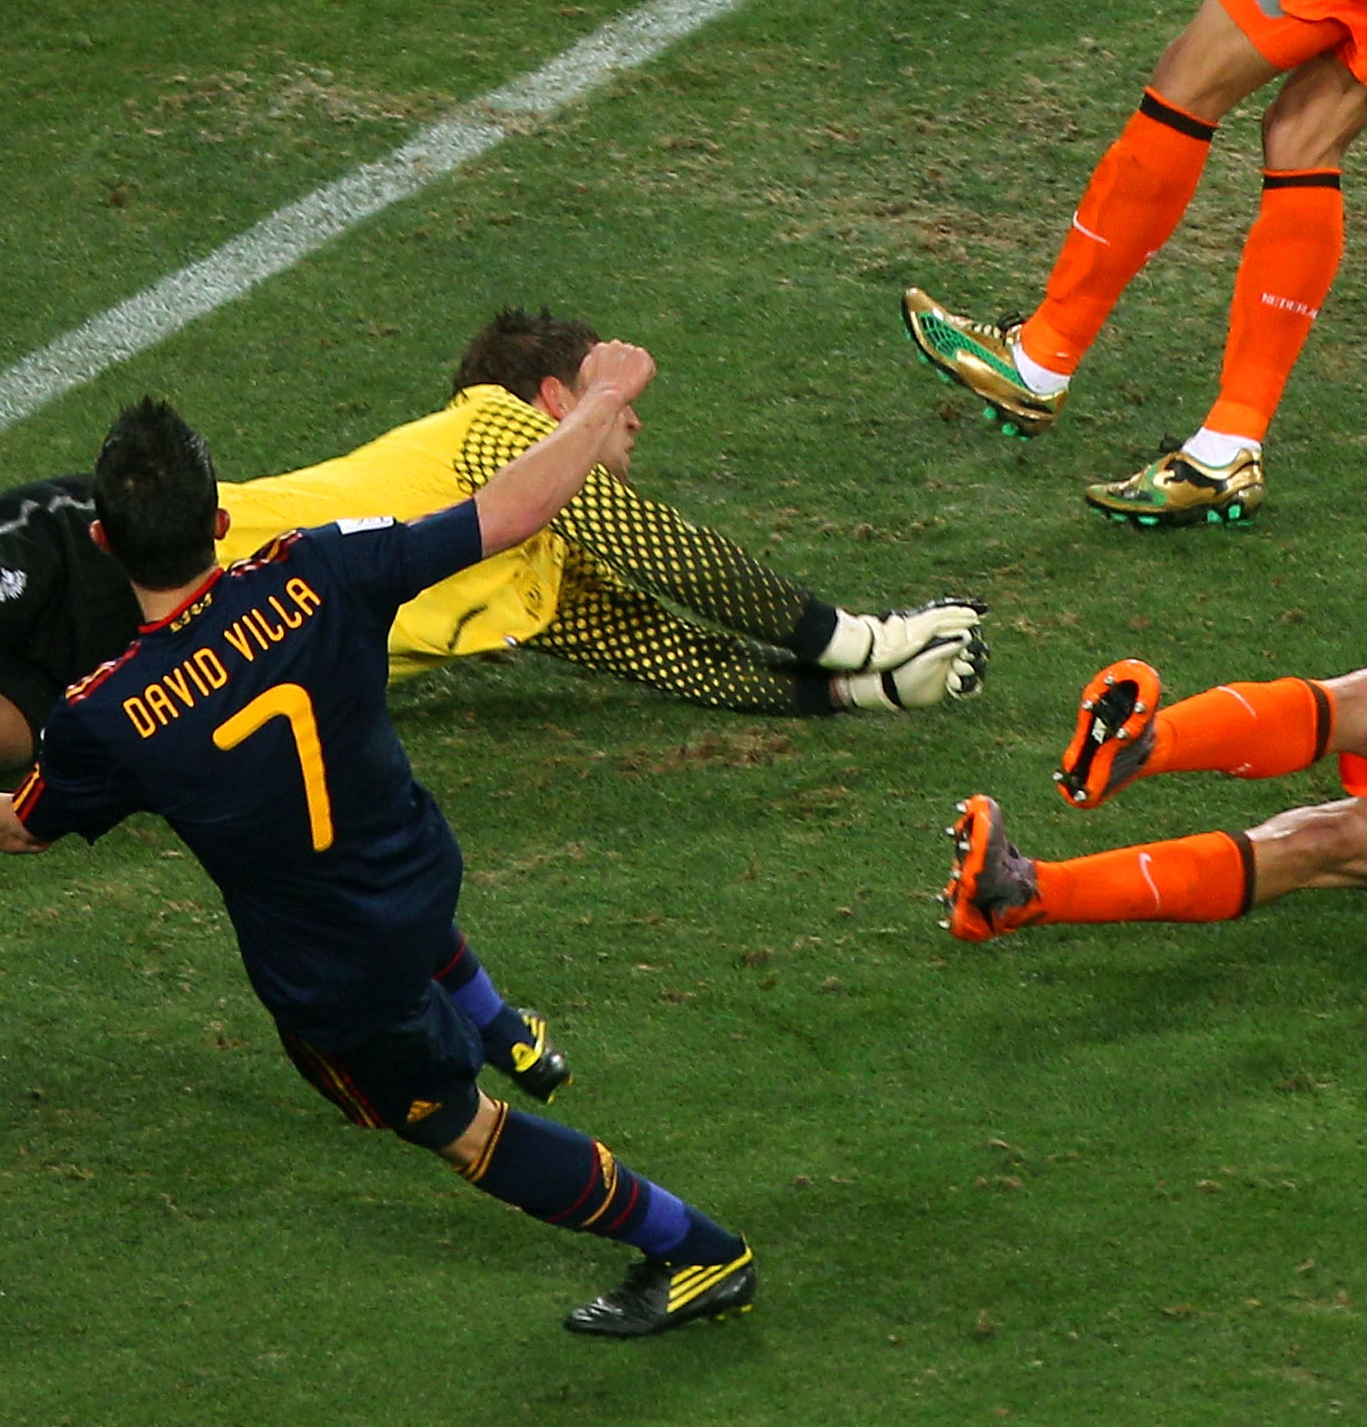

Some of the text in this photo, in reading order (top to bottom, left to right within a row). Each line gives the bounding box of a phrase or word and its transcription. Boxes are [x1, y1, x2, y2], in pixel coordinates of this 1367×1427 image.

[122, 647, 229, 739] DAVID
[223, 577, 322, 663] VILLA
[211, 682, 333, 853] 7
